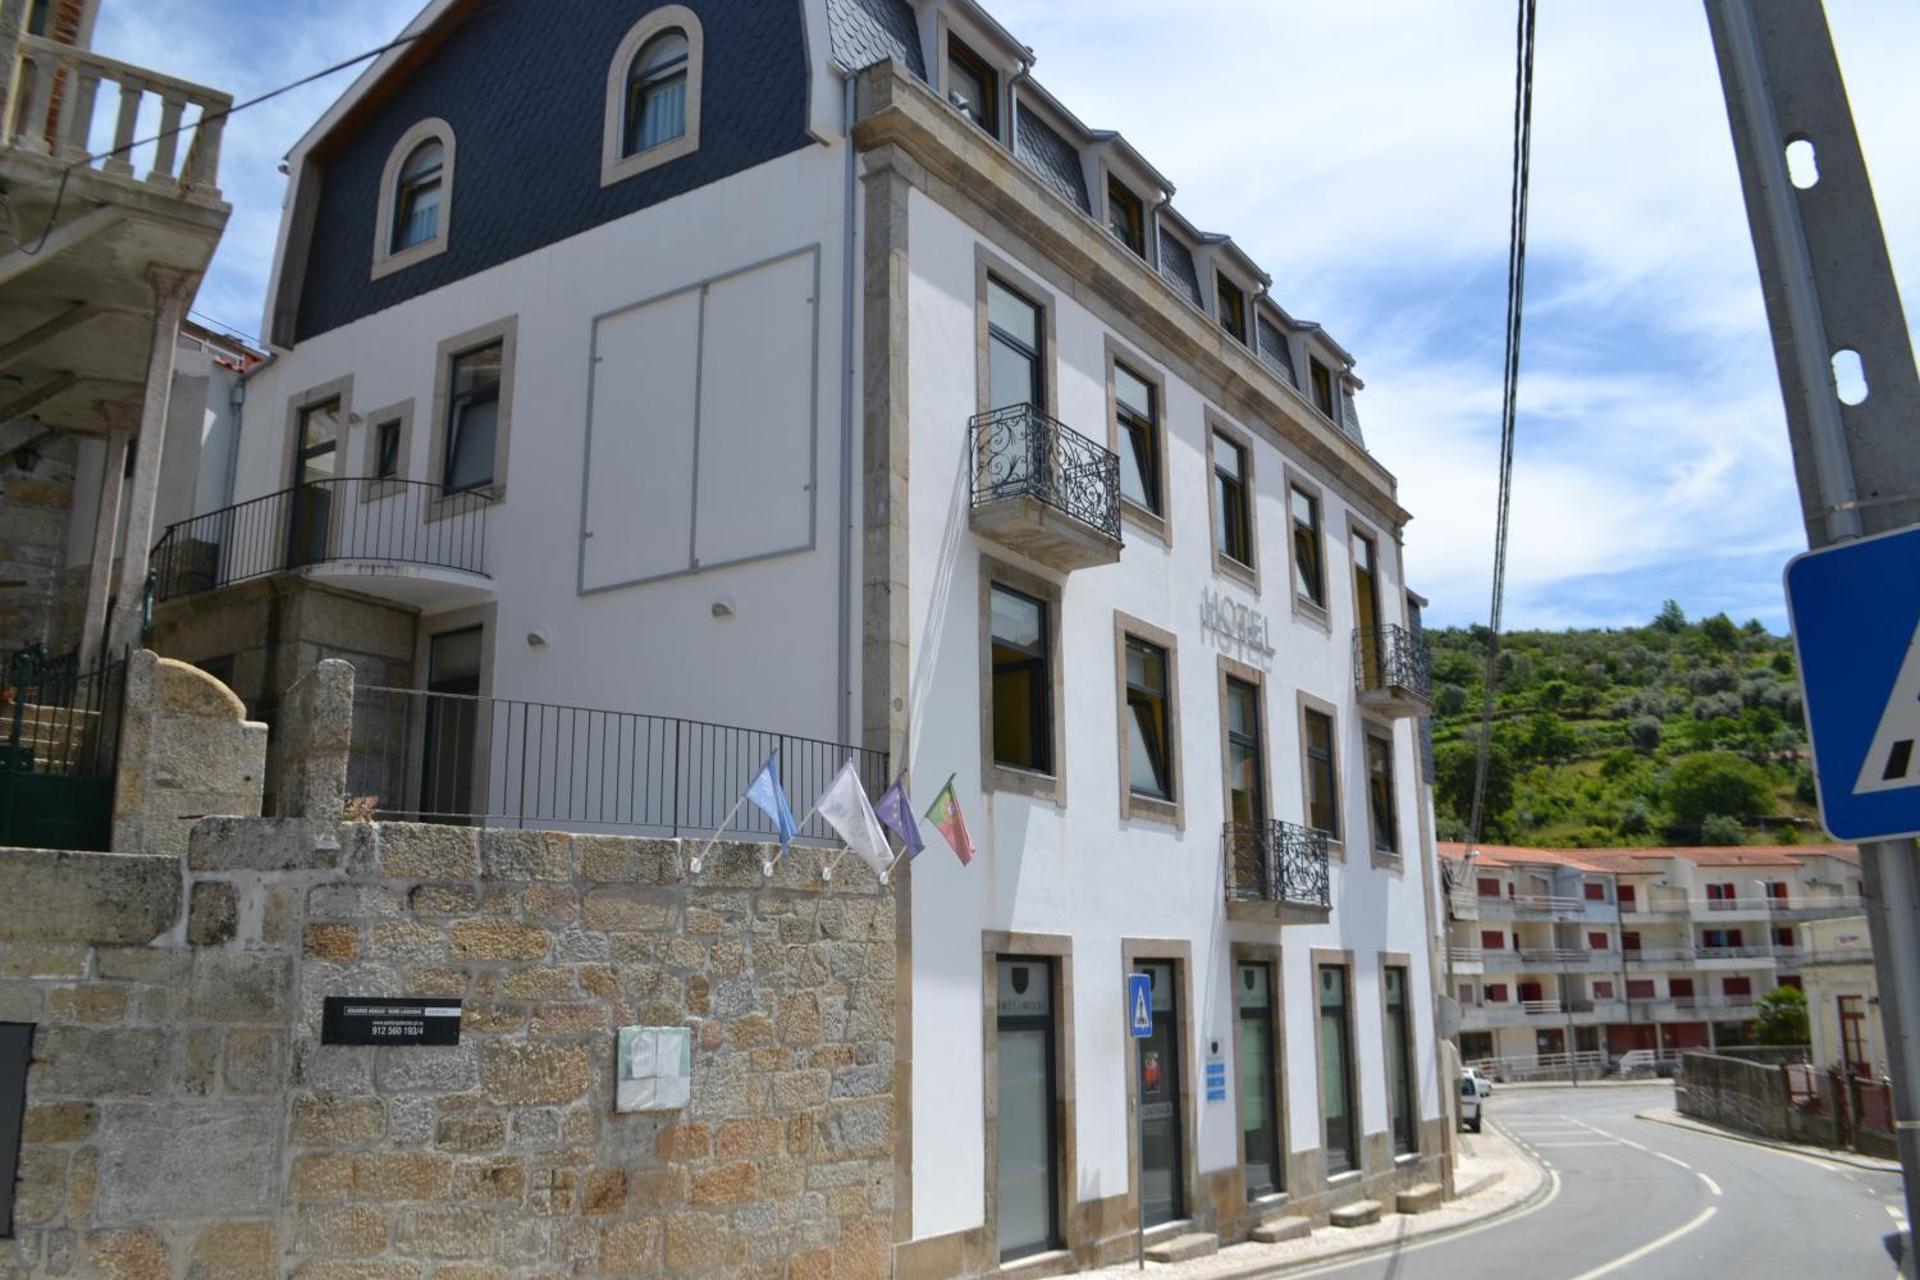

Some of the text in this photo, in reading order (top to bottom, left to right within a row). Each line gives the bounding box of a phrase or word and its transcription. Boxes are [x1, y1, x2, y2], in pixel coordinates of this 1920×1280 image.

[1201, 585, 1276, 659] HOTEL
[372, 1026, 386, 1035] 912
[387, 1026, 402, 1035] 560
